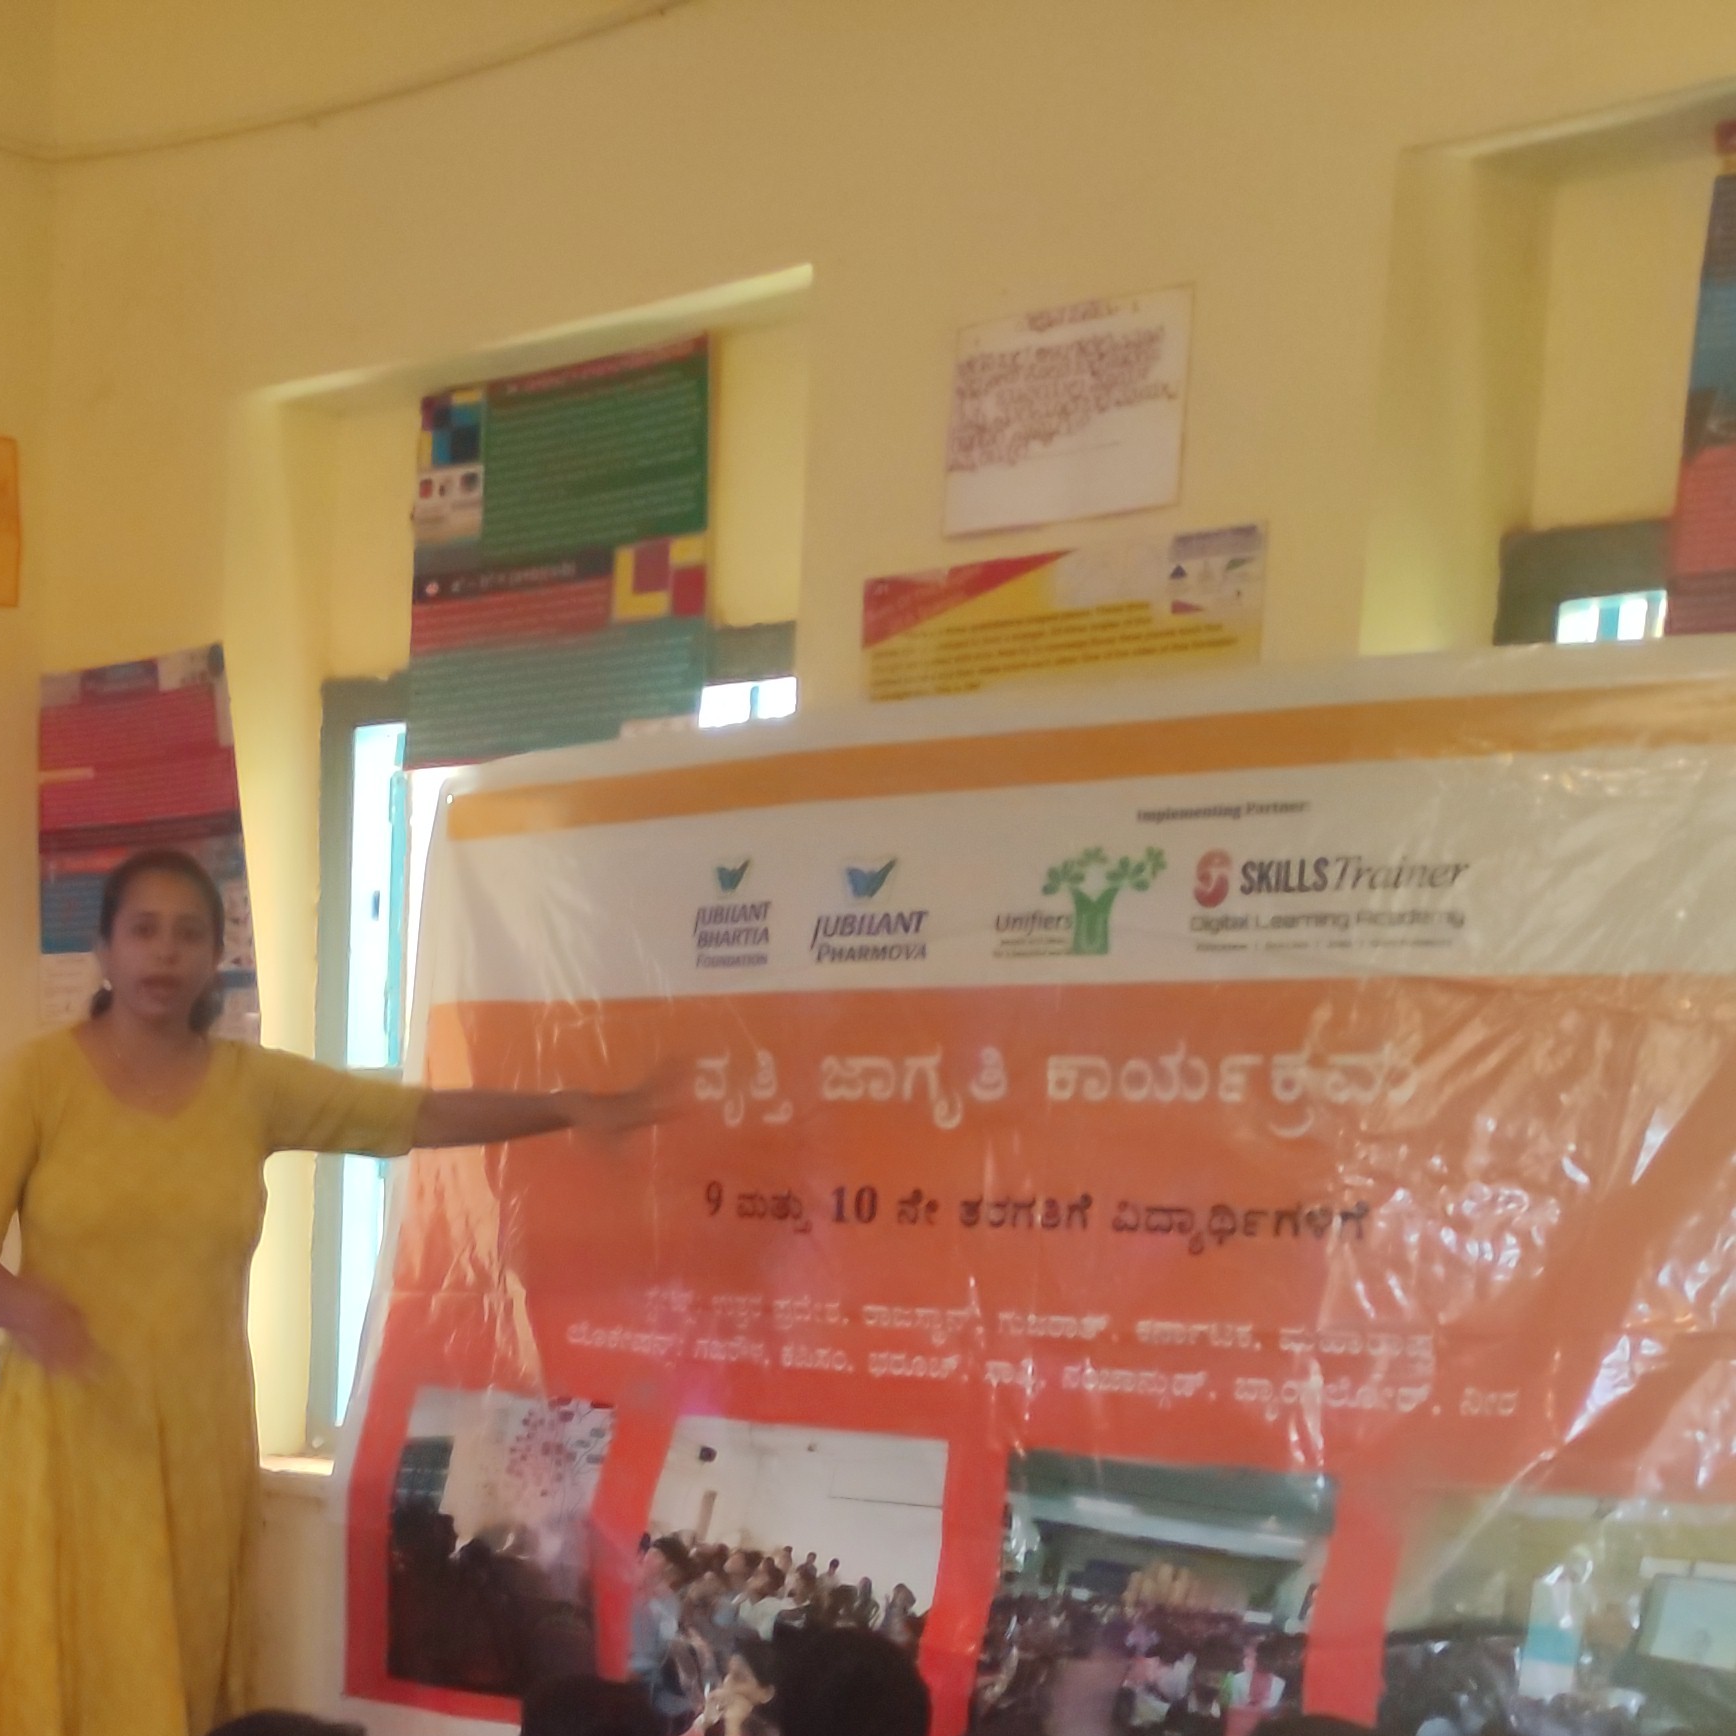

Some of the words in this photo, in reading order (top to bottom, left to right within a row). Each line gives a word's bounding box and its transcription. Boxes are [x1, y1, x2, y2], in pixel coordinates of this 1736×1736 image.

[1136, 802, 1243, 825] Implementing
[694, 901, 772, 936] JUBILANT
[810, 909, 930, 951] JUBILANT
[994, 910, 1074, 937] Unifiers
[1190, 914, 1249, 935] Digital
[1255, 912, 1350, 933] Learning
[696, 926, 770, 950] BHARTIA
[693, 1047, 795, 1128] ವೃತ್ತಿ
[819, 1044, 1009, 1130] ಜಾಗೃತಿ
[1045, 1039, 1422, 1138] ಕಾರ್ಯಕ್ರಮ
[704, 1180, 724, 1217] 9
[736, 1187, 813, 1235] ಮತ್ತು
[830, 1183, 878, 1225] 10
